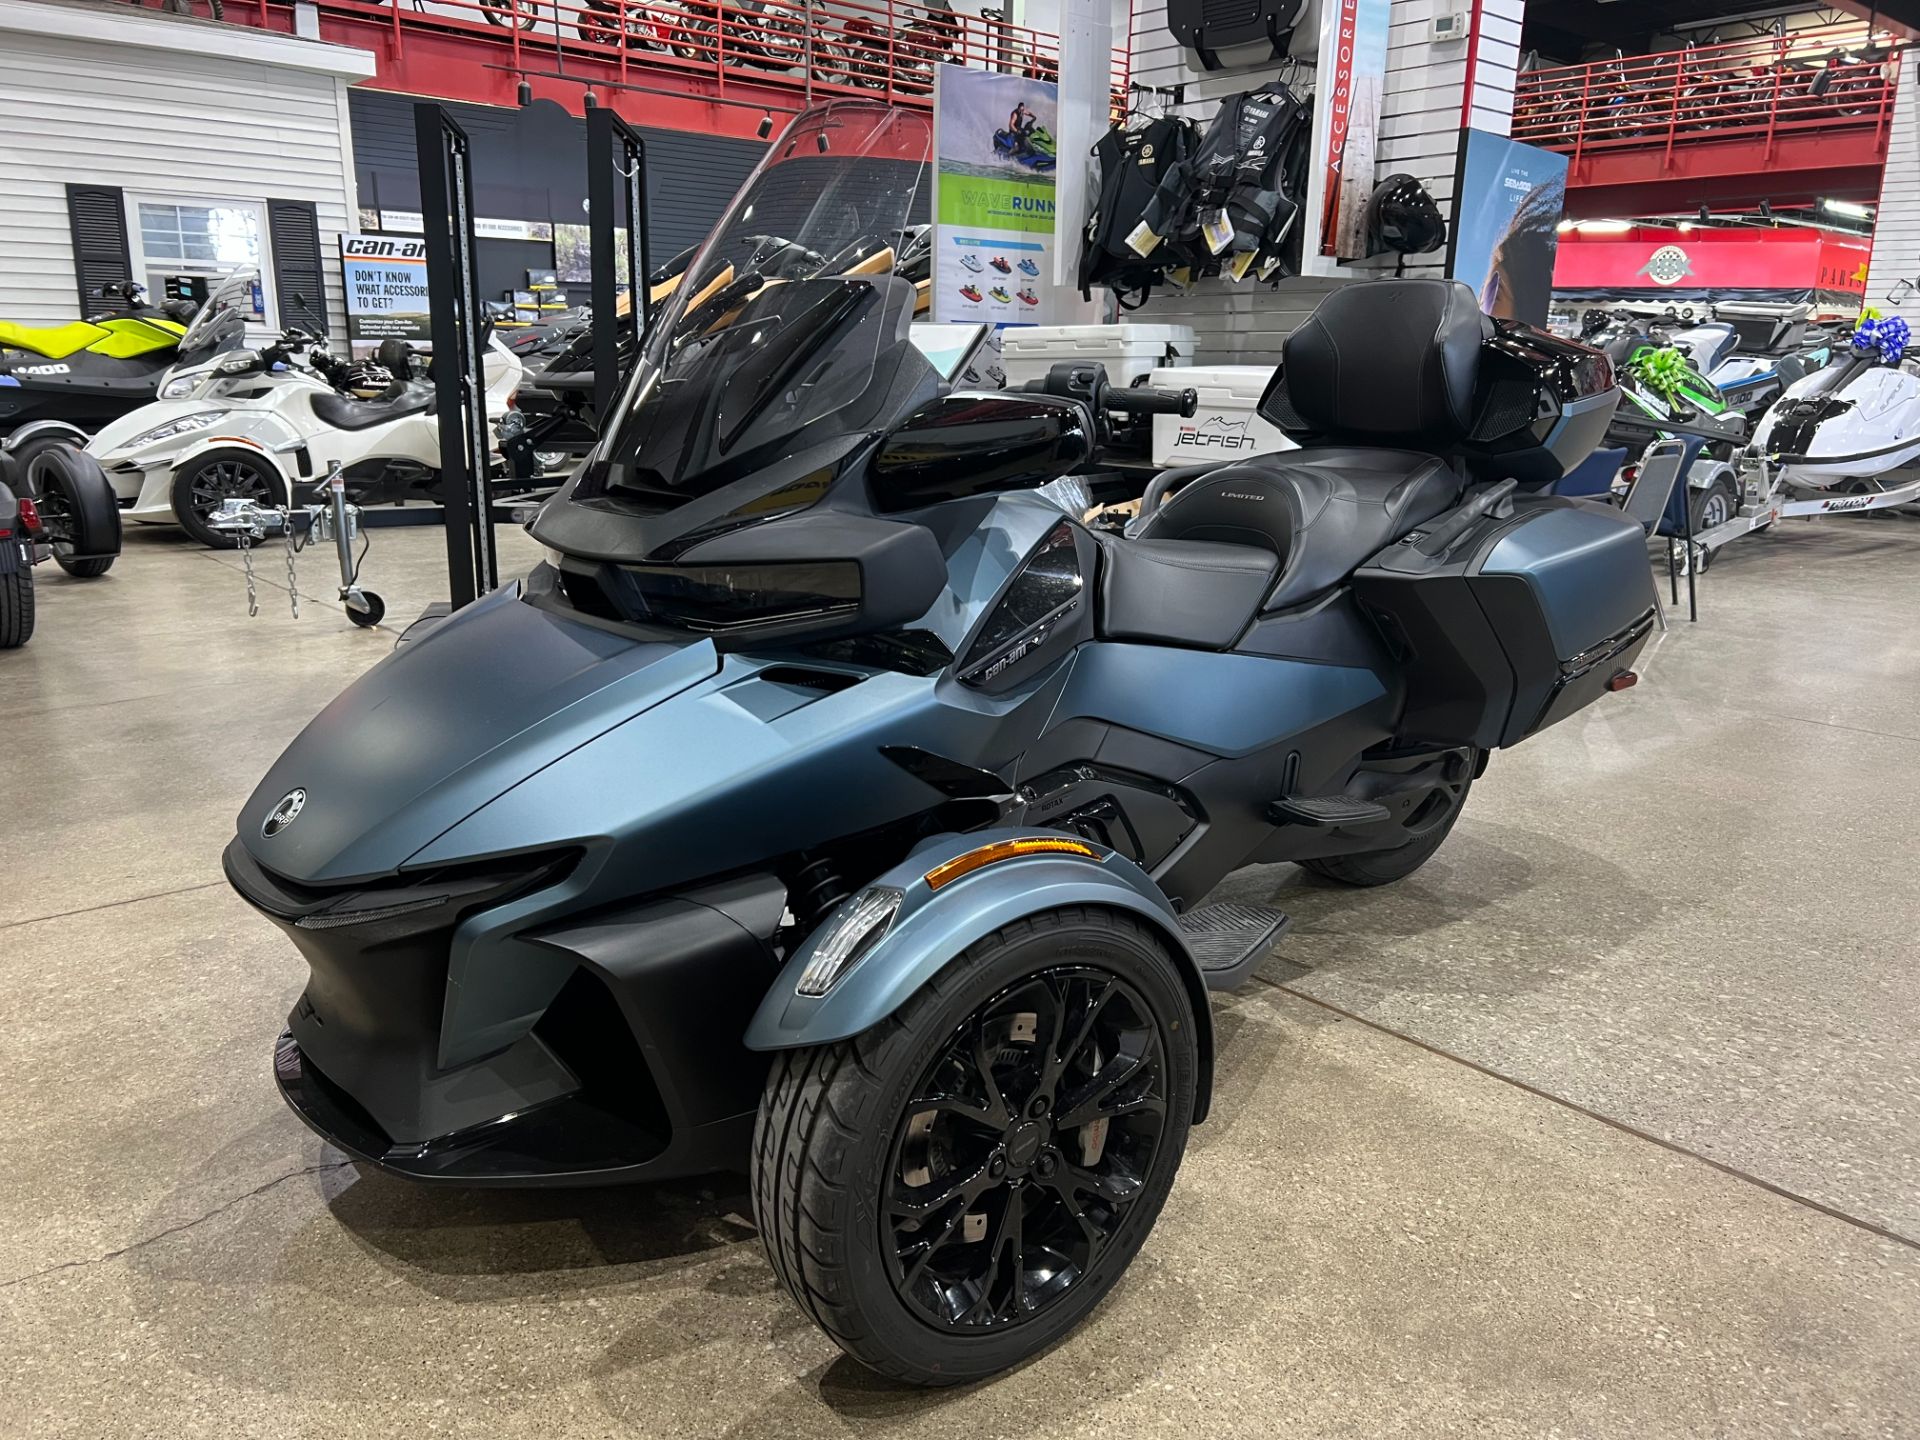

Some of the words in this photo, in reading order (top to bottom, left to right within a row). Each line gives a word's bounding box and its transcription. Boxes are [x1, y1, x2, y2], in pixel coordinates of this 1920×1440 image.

[355, 270, 382, 283] DON'T
[385, 272, 412, 284] KNOW
[356, 284, 381, 296] WHAT
[357, 297, 369, 308] TO
[372, 298, 393, 309] GET?
[1221, 491, 1265, 501] LIMITED
[1828, 497, 1871, 511] TRITON
[985, 643, 1028, 681] can-am
[1041, 797, 1064, 812] ROTAX
[274, 811, 290, 825] BRP
